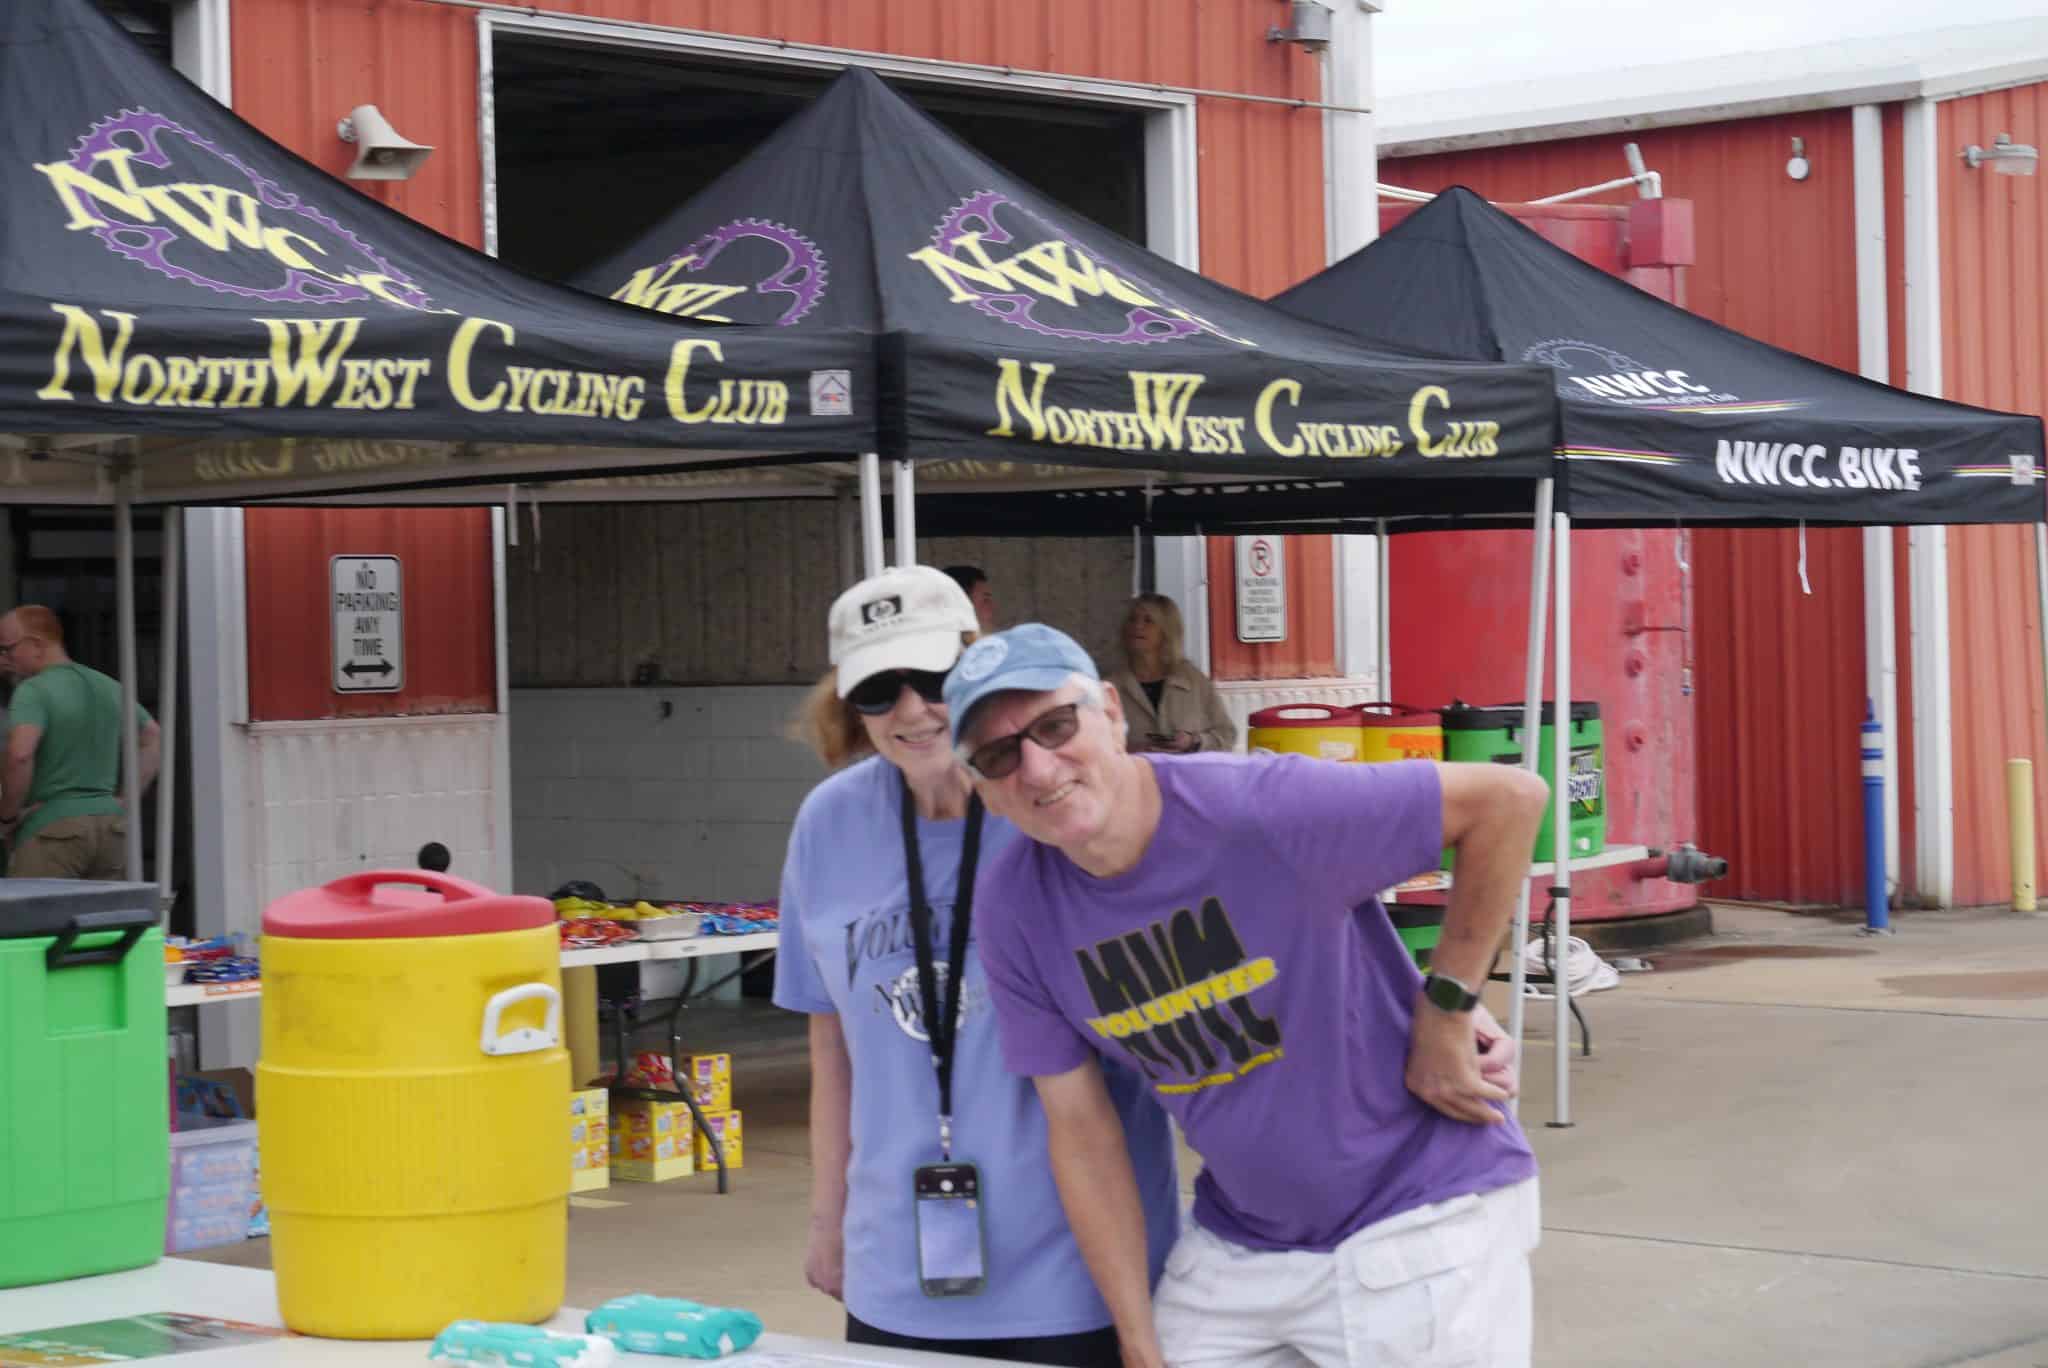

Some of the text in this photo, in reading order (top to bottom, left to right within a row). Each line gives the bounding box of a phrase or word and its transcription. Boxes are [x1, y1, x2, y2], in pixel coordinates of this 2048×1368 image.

[446, 316, 646, 421] CYCLING
[664, 338, 788, 425] CLUB
[1568, 370, 1711, 398] NWCC
[1253, 378, 1404, 459] CYCLING
[1408, 385, 1501, 458] CLUB
[1713, 438, 1924, 492] NWCC.BIKE
[355, 569, 377, 590] NO
[335, 591, 400, 612] PARKING
[352, 615, 381, 634] ANY
[352, 637, 384, 657] TIME
[1085, 956, 1279, 1039] VOLUNTEER
